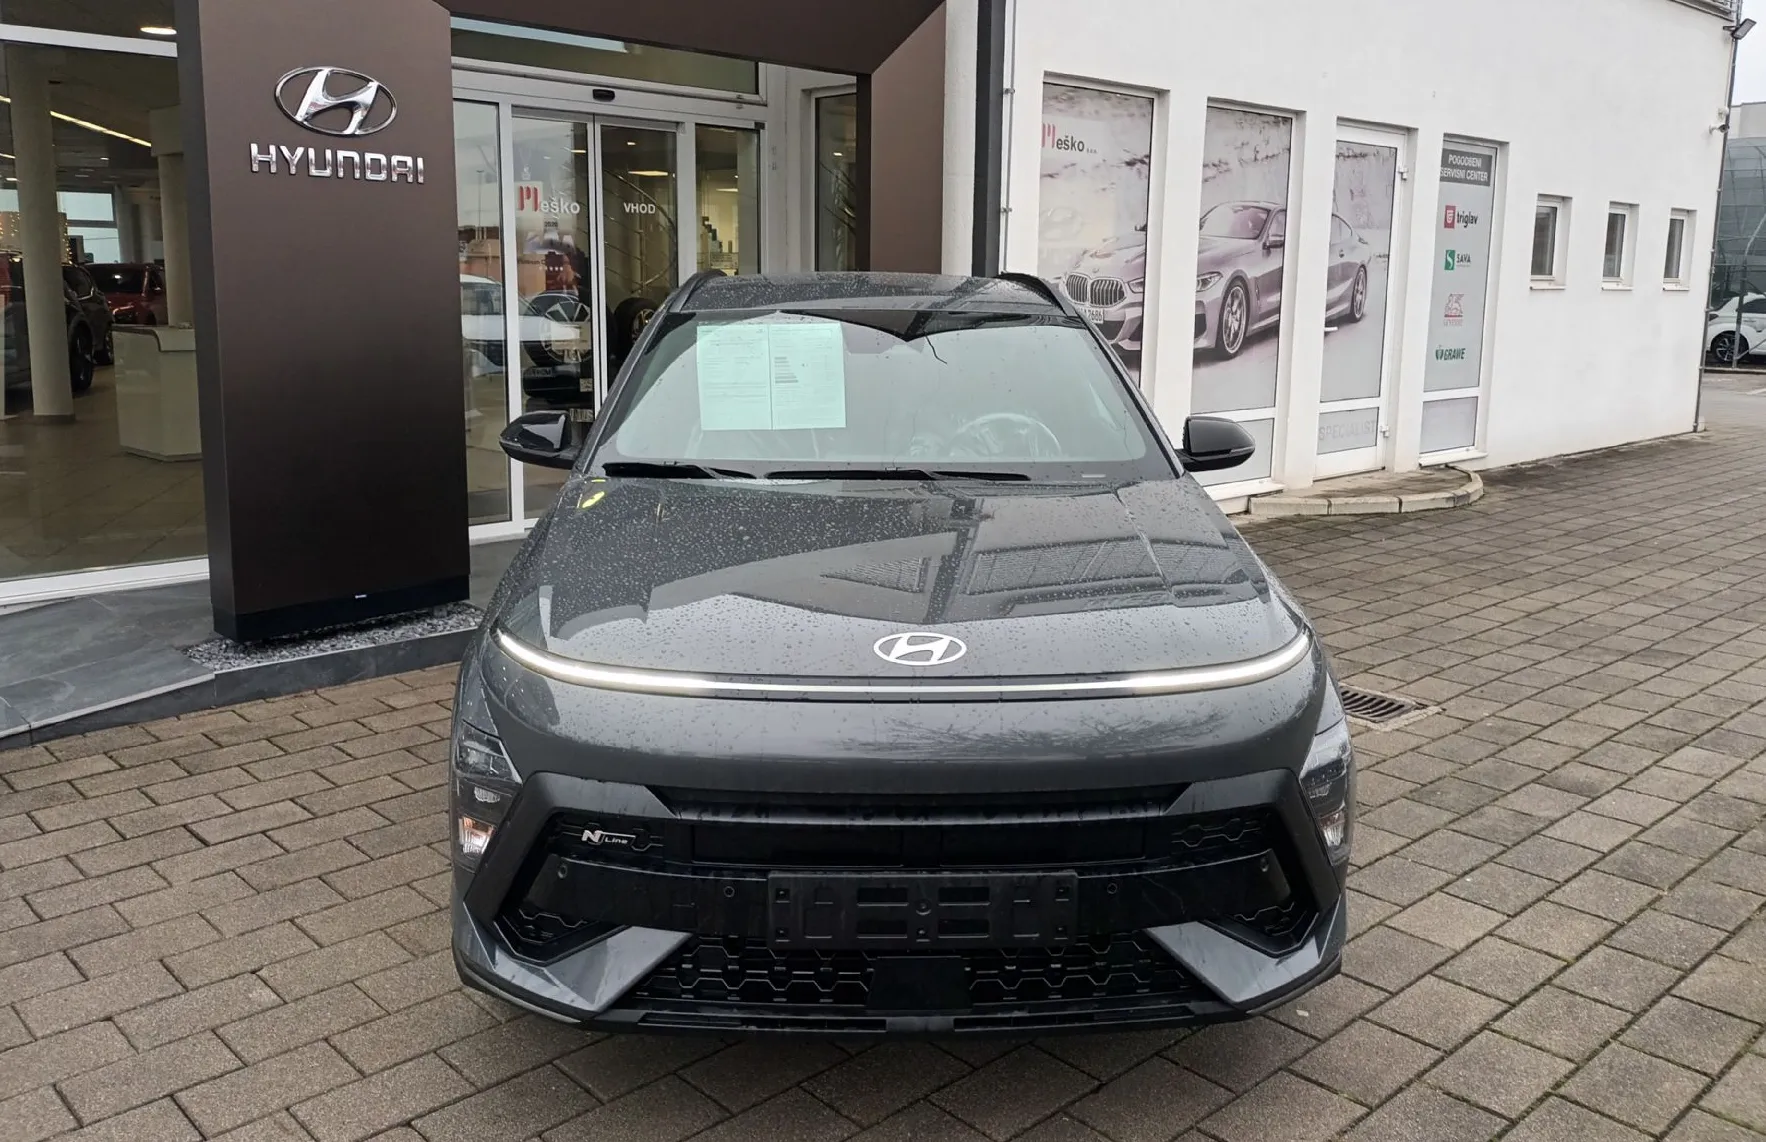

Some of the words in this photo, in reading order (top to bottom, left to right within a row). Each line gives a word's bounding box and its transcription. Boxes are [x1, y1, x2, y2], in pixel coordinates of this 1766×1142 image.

[250, 143, 425, 184] HYUNDAI
[1440, 166, 1466, 180] SERVISNI
[1466, 170, 1488, 182] CENTER
[623, 202, 656, 214] VHOD
[1457, 210, 1479, 229] triglav
[1456, 253, 1471, 263] SAVA
[1444, 348, 1466, 361] GRAWE
[1318, 420, 1377, 441] SPECIALIST
[581, 829, 602, 843] N
